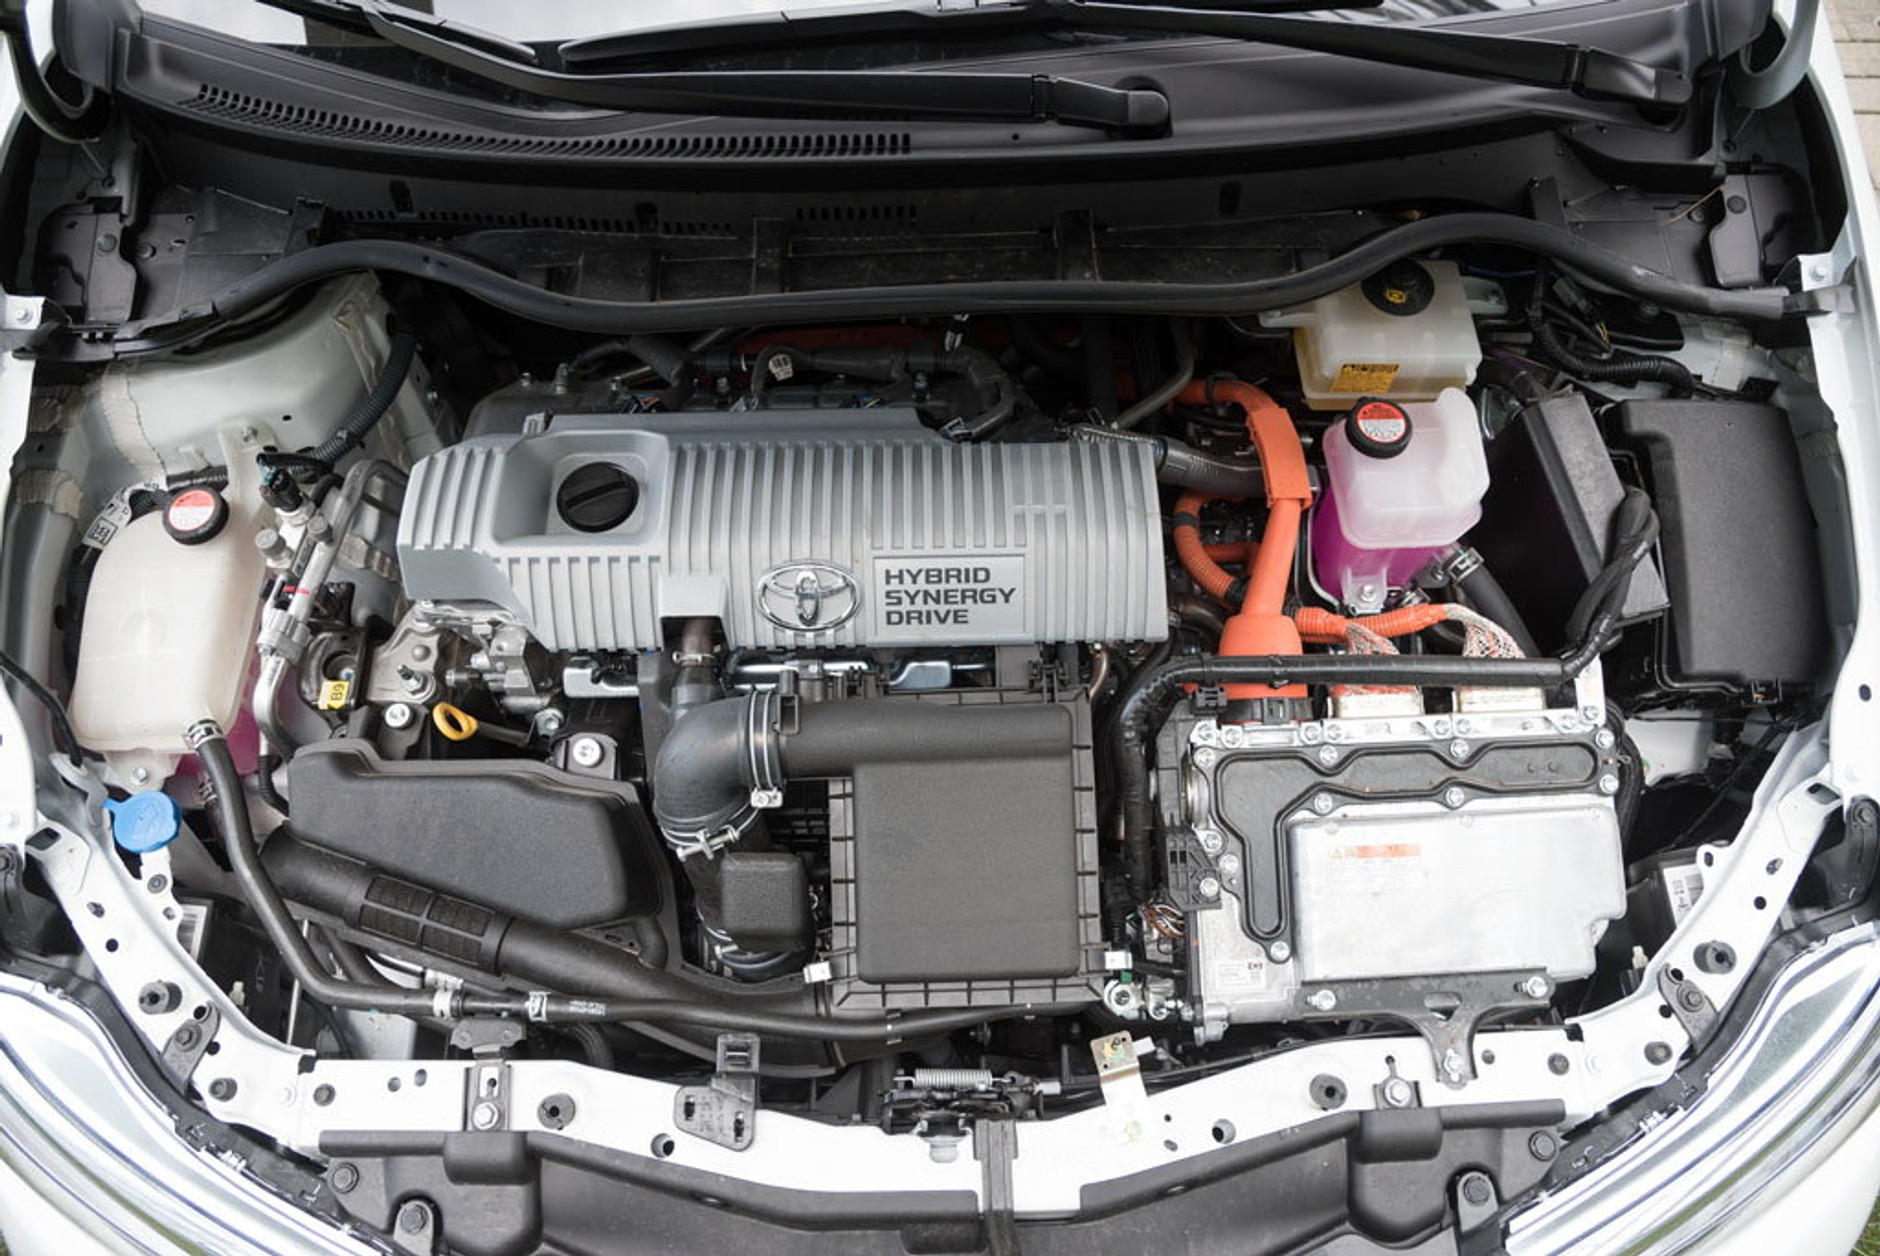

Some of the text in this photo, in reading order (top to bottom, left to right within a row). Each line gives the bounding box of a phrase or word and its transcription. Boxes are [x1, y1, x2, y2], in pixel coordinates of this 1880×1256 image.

[884, 567, 991, 585] HYBRID
[884, 587, 1017, 606] SYNERGY
[885, 609, 970, 626] DRIVE
